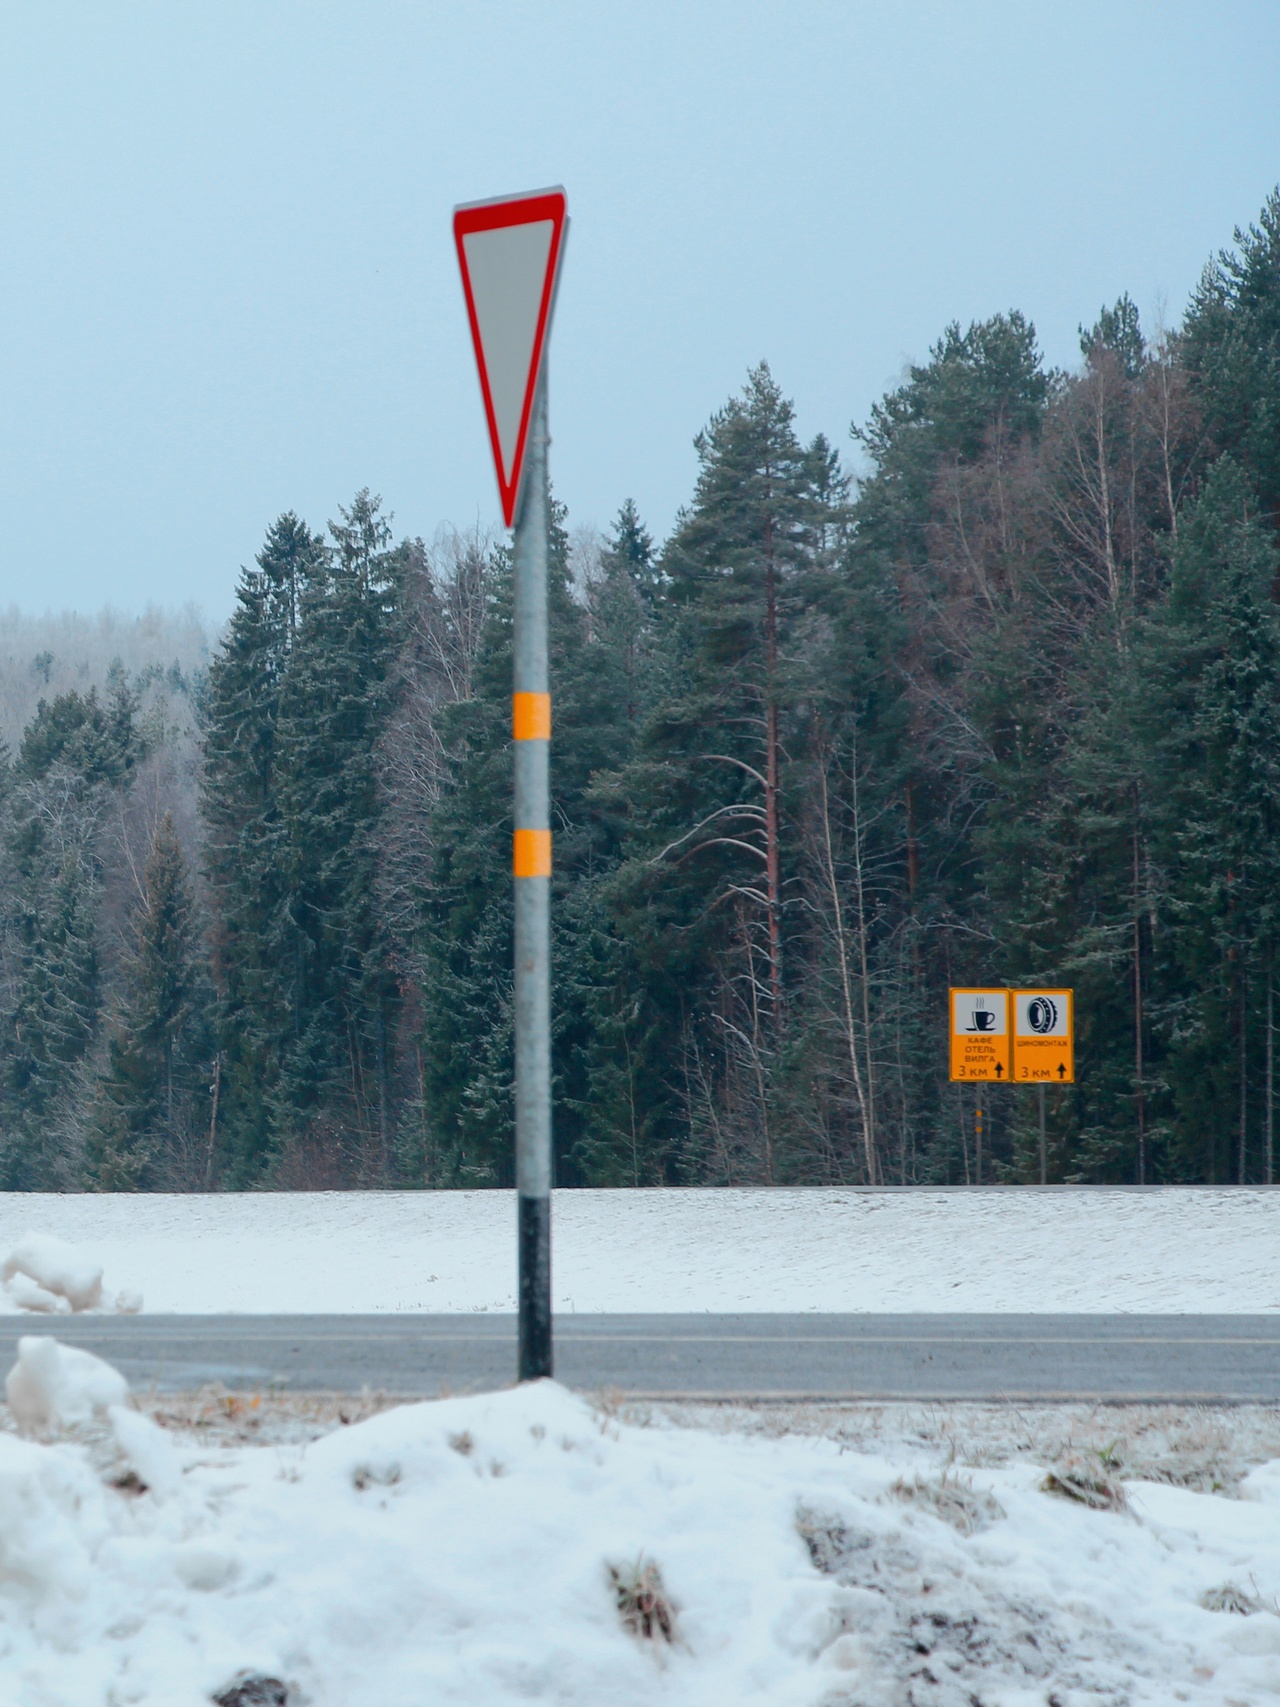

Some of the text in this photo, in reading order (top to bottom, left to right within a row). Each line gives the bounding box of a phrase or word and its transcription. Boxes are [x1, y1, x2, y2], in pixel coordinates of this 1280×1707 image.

[965, 1045, 996, 1053] ОТЕЛЬ
[965, 1055, 996, 1063] ВИЛГА
[958, 1065, 966, 1077] 3
[1021, 1066, 1029, 1078] 3
